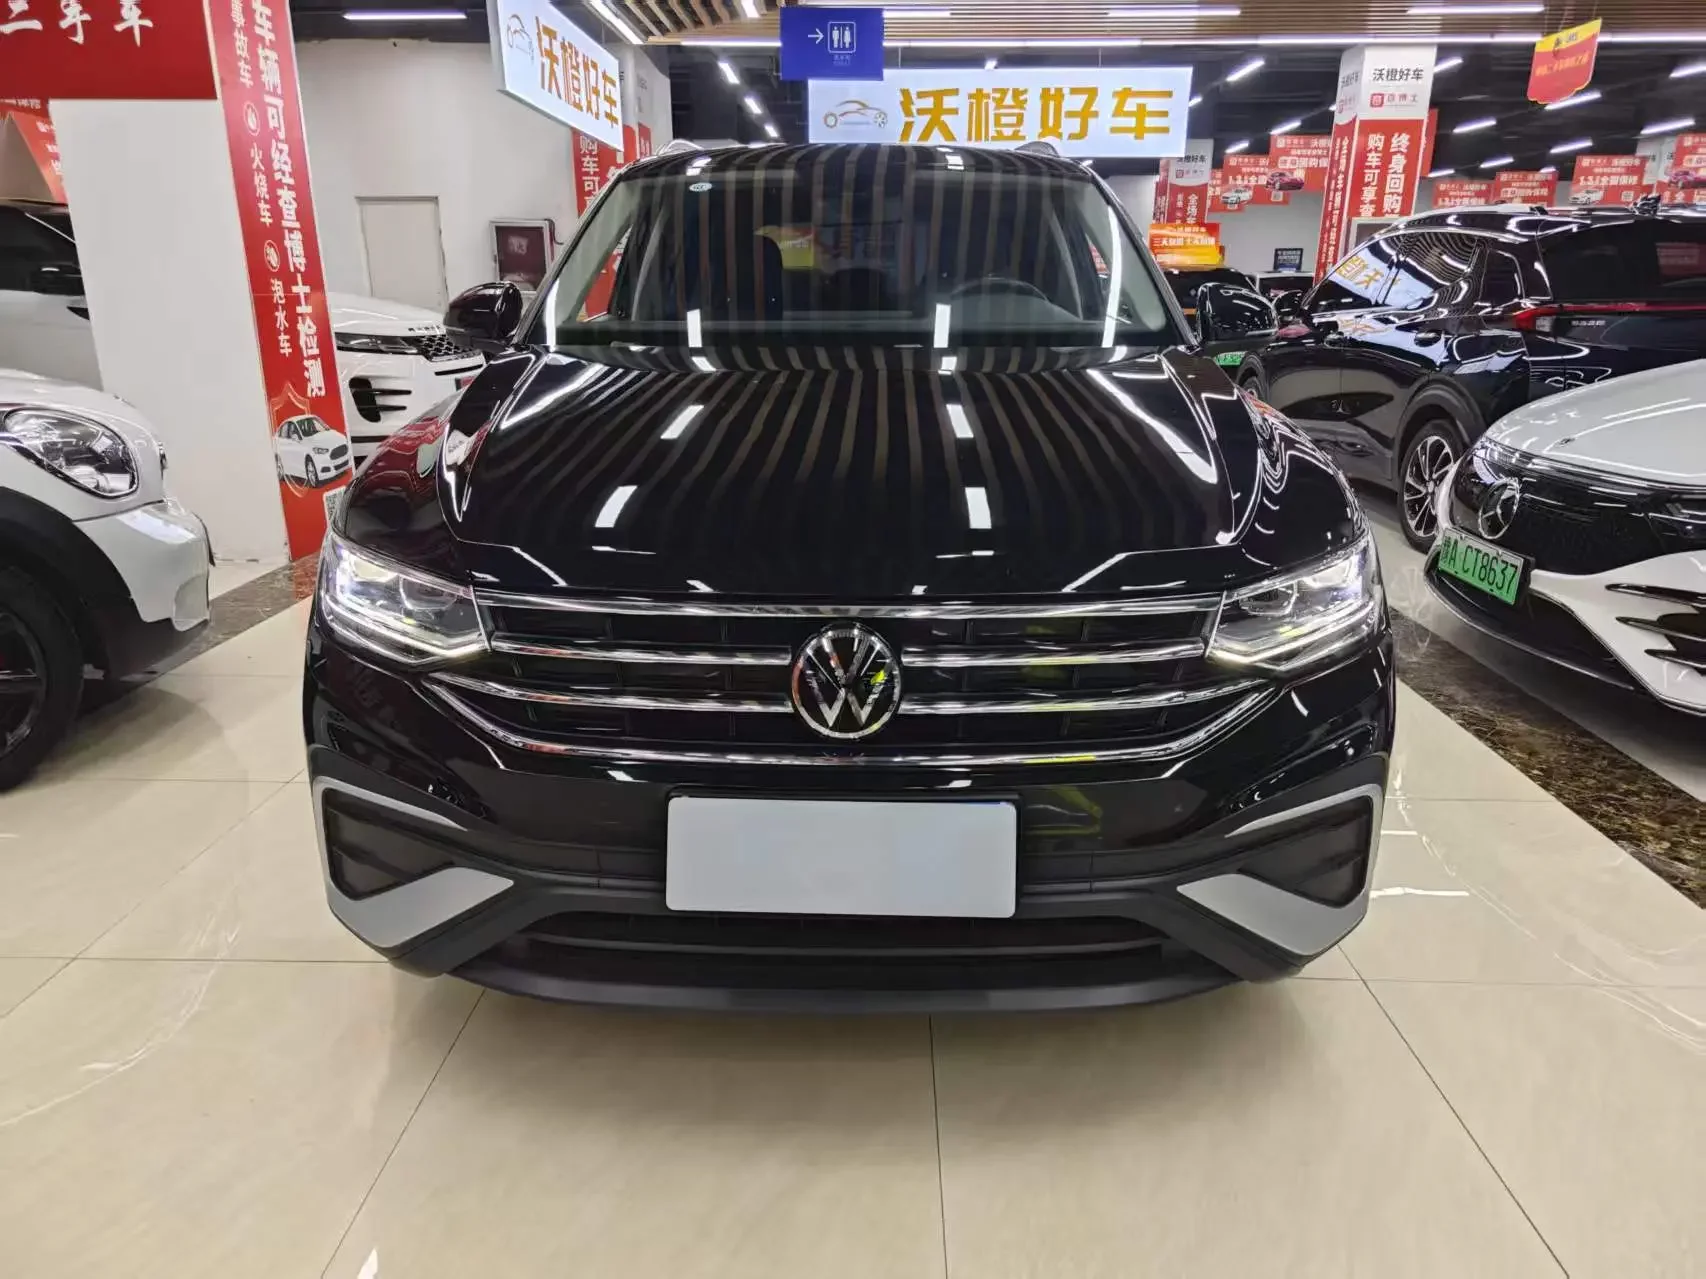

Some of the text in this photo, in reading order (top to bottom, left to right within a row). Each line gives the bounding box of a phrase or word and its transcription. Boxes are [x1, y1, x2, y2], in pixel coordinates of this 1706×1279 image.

[535, 16, 619, 128] 沃橙好车
[1372, 67, 1424, 82] 沃橙好车
[900, 87, 1174, 142] 沃橙好车
[250, 143, 272, 227] 火烧车
[1383, 132, 1411, 217] 终身回购
[270, 278, 292, 357] 泡水车
